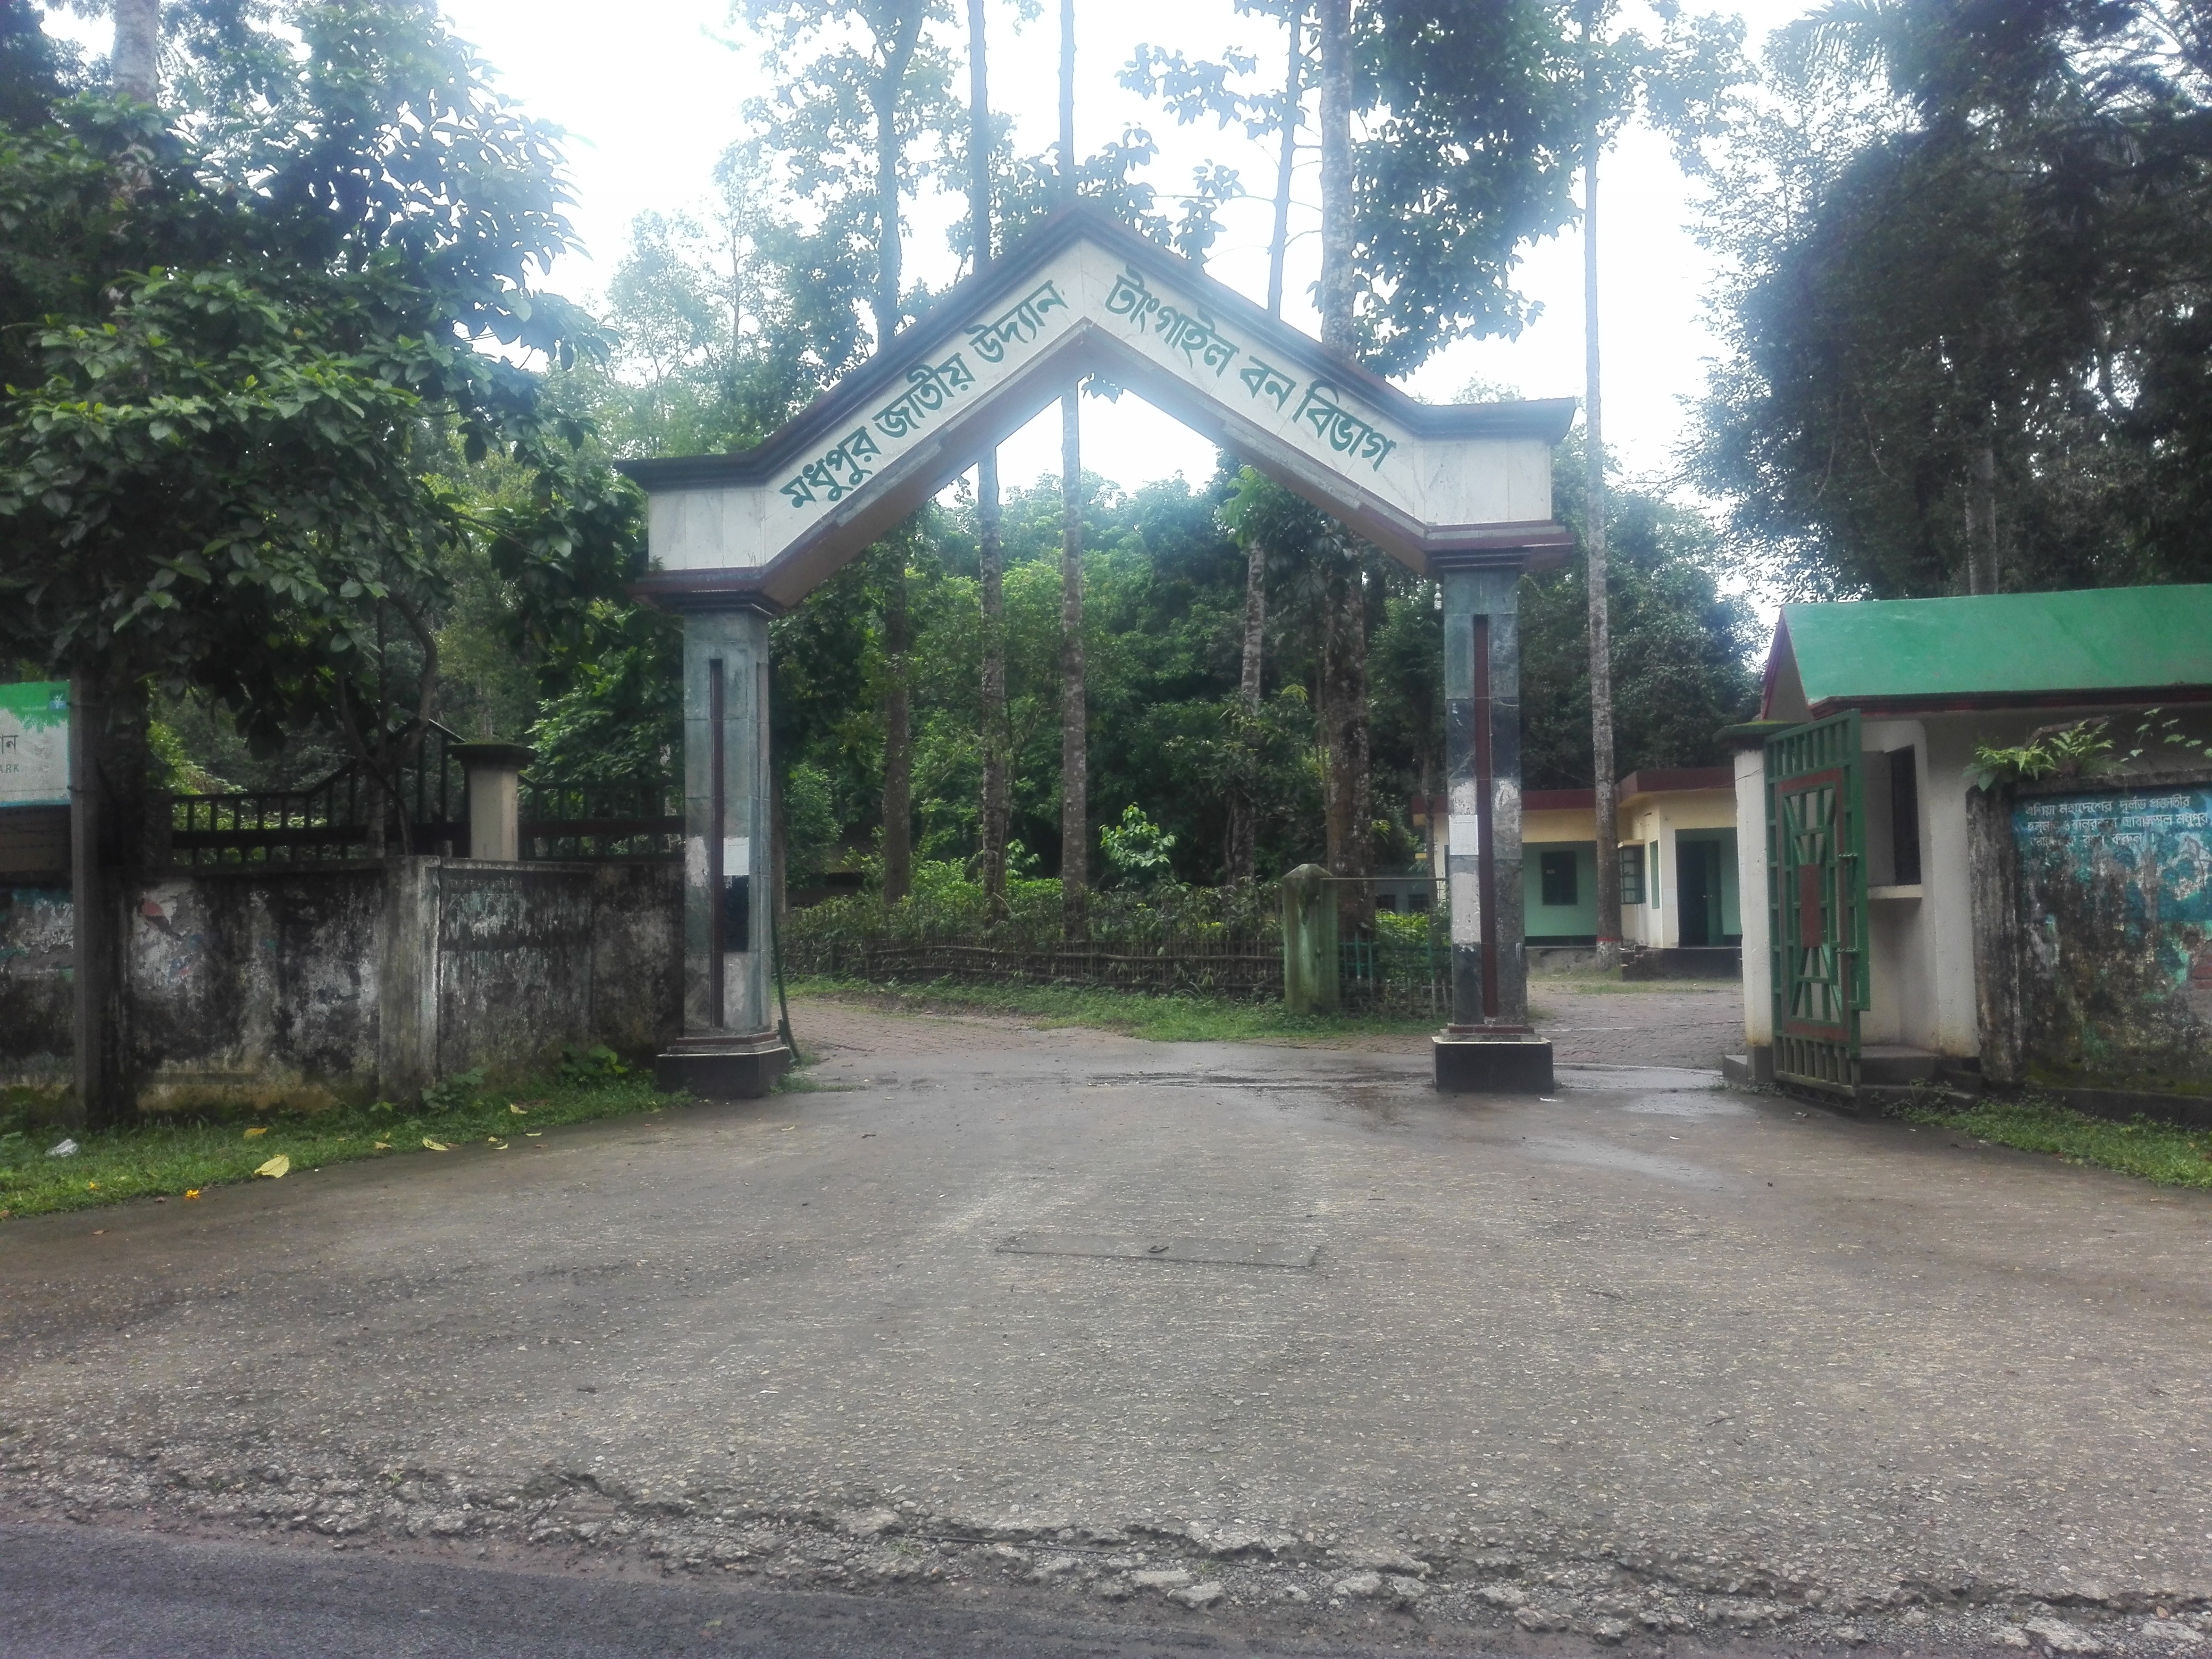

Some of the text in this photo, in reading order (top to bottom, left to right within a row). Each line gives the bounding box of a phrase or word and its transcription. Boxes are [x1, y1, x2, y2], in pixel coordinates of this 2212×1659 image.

[780, 280, 1069, 508] মধুপুর জাতীয় উদ্যান
[1104, 264, 1396, 472] টাংগাইল বন বিভাগ
